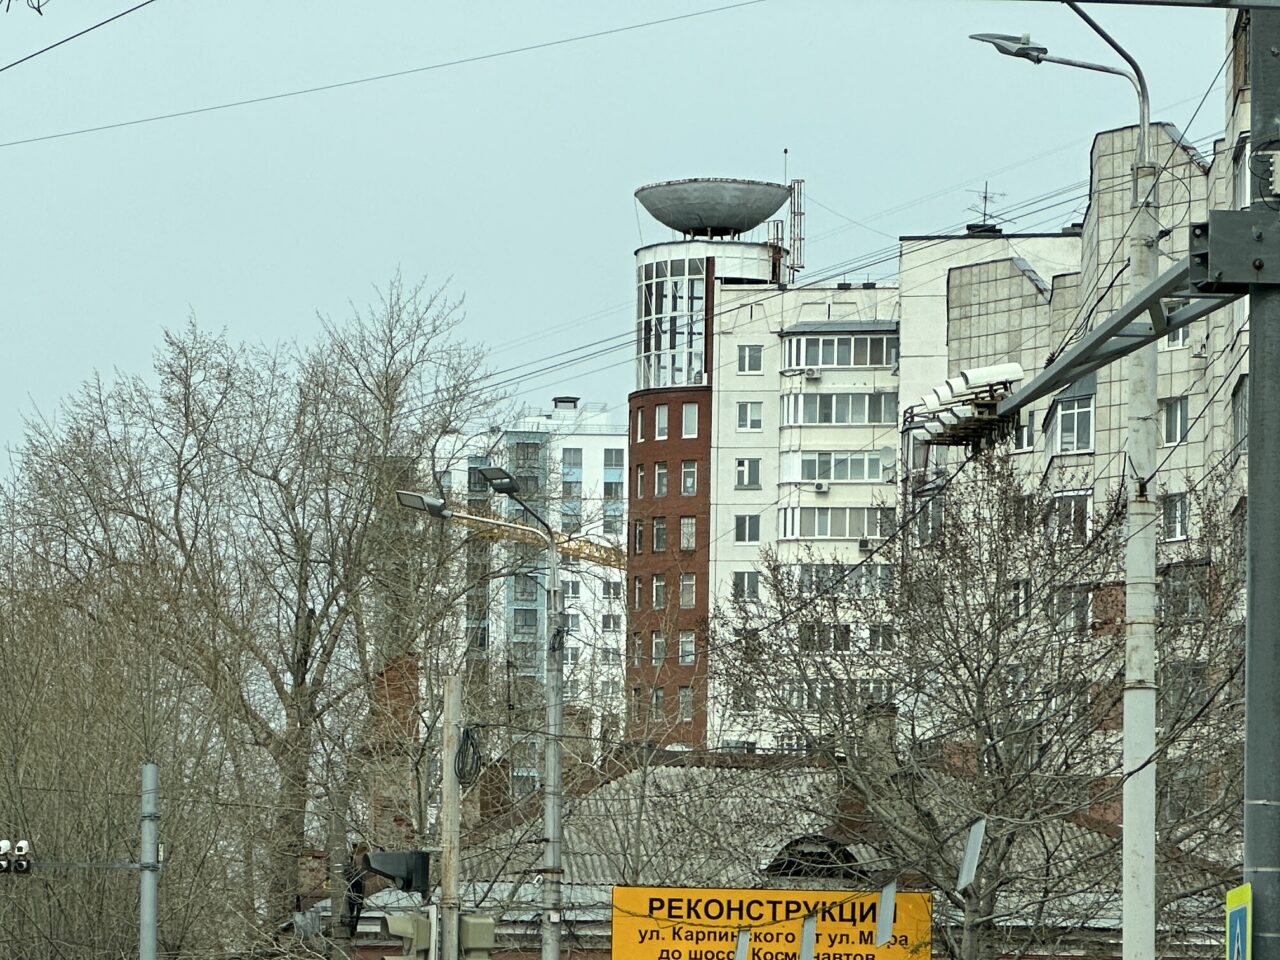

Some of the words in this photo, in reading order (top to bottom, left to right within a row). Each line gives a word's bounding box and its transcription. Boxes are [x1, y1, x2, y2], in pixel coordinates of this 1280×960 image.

[647, 897, 898, 925] РЕКОНСТРУКЦИ
[638, 929, 665, 944] ул.
[672, 926, 796, 945] Карпинкого
[827, 933, 855, 948] ул.
[858, 930, 909, 948] Мра
